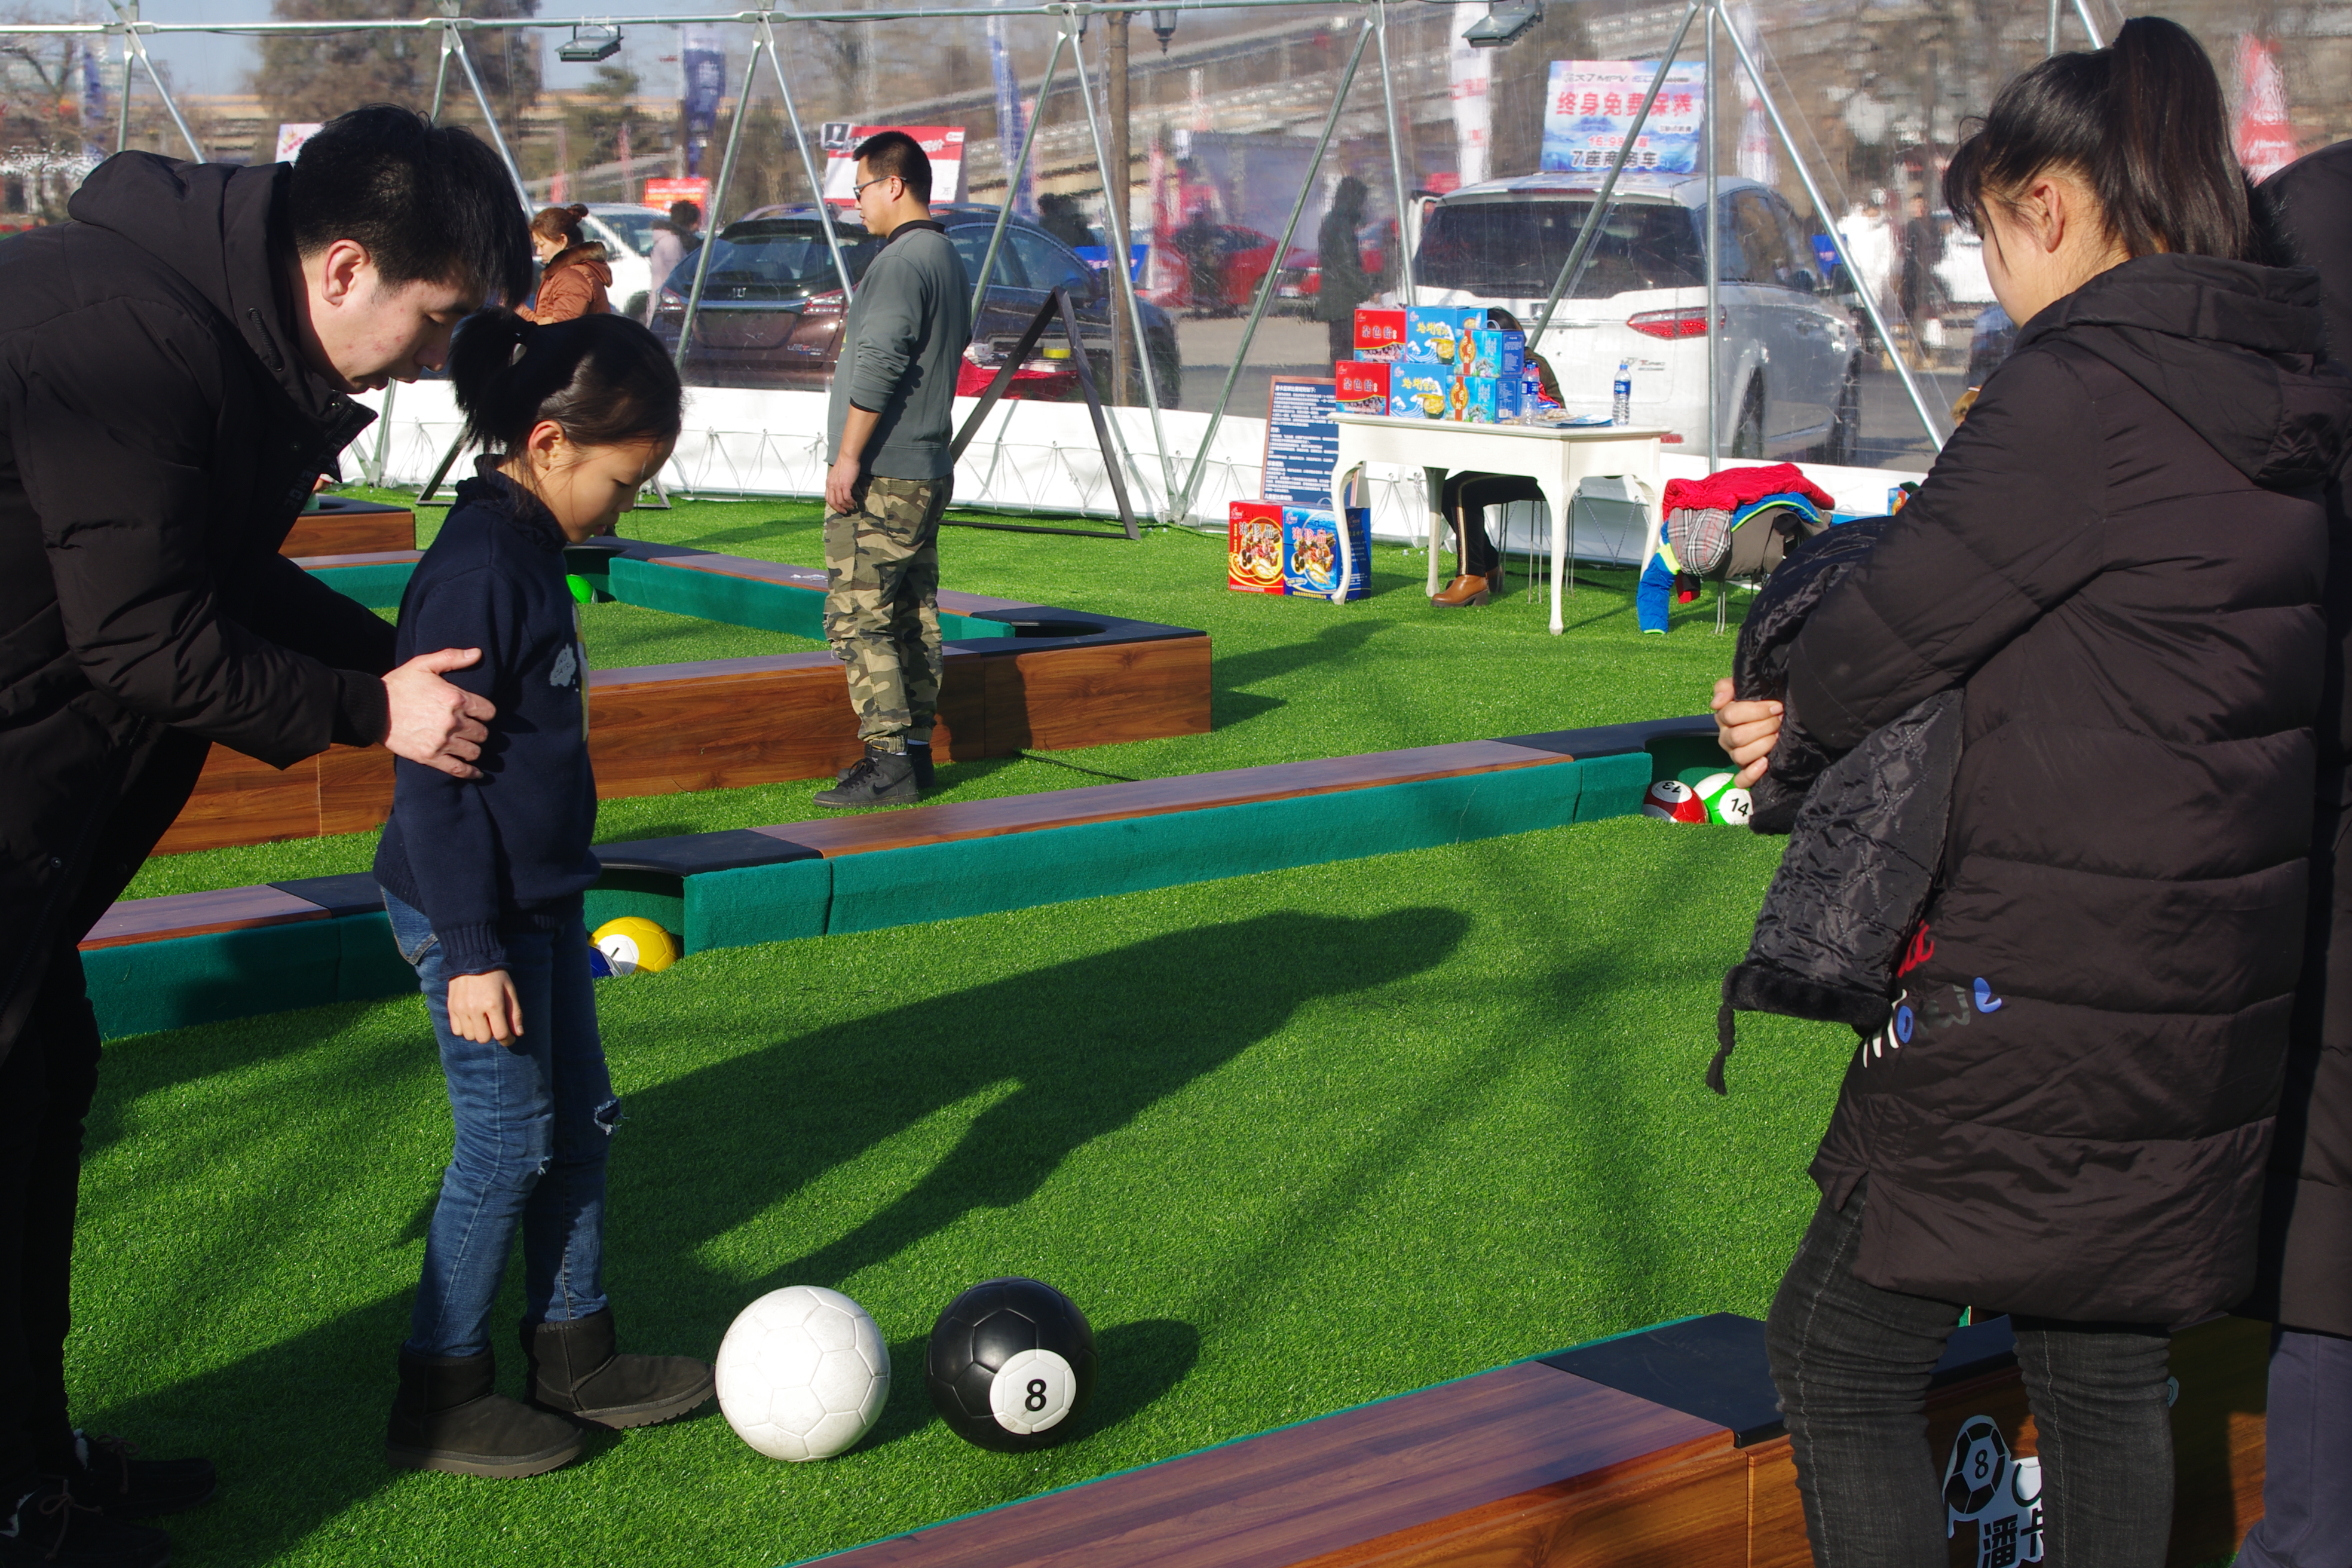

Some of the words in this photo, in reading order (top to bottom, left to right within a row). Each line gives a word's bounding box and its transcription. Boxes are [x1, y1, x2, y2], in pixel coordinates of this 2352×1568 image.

[1239, 522, 1274, 538] 海珍品
[1292, 526, 1327, 544] 海珍品
[1662, 782, 1681, 793] 13
[1731, 798, 1749, 817] 14
[1025, 1379, 1047, 1412] 8
[1975, 1449, 1989, 1480] 8
